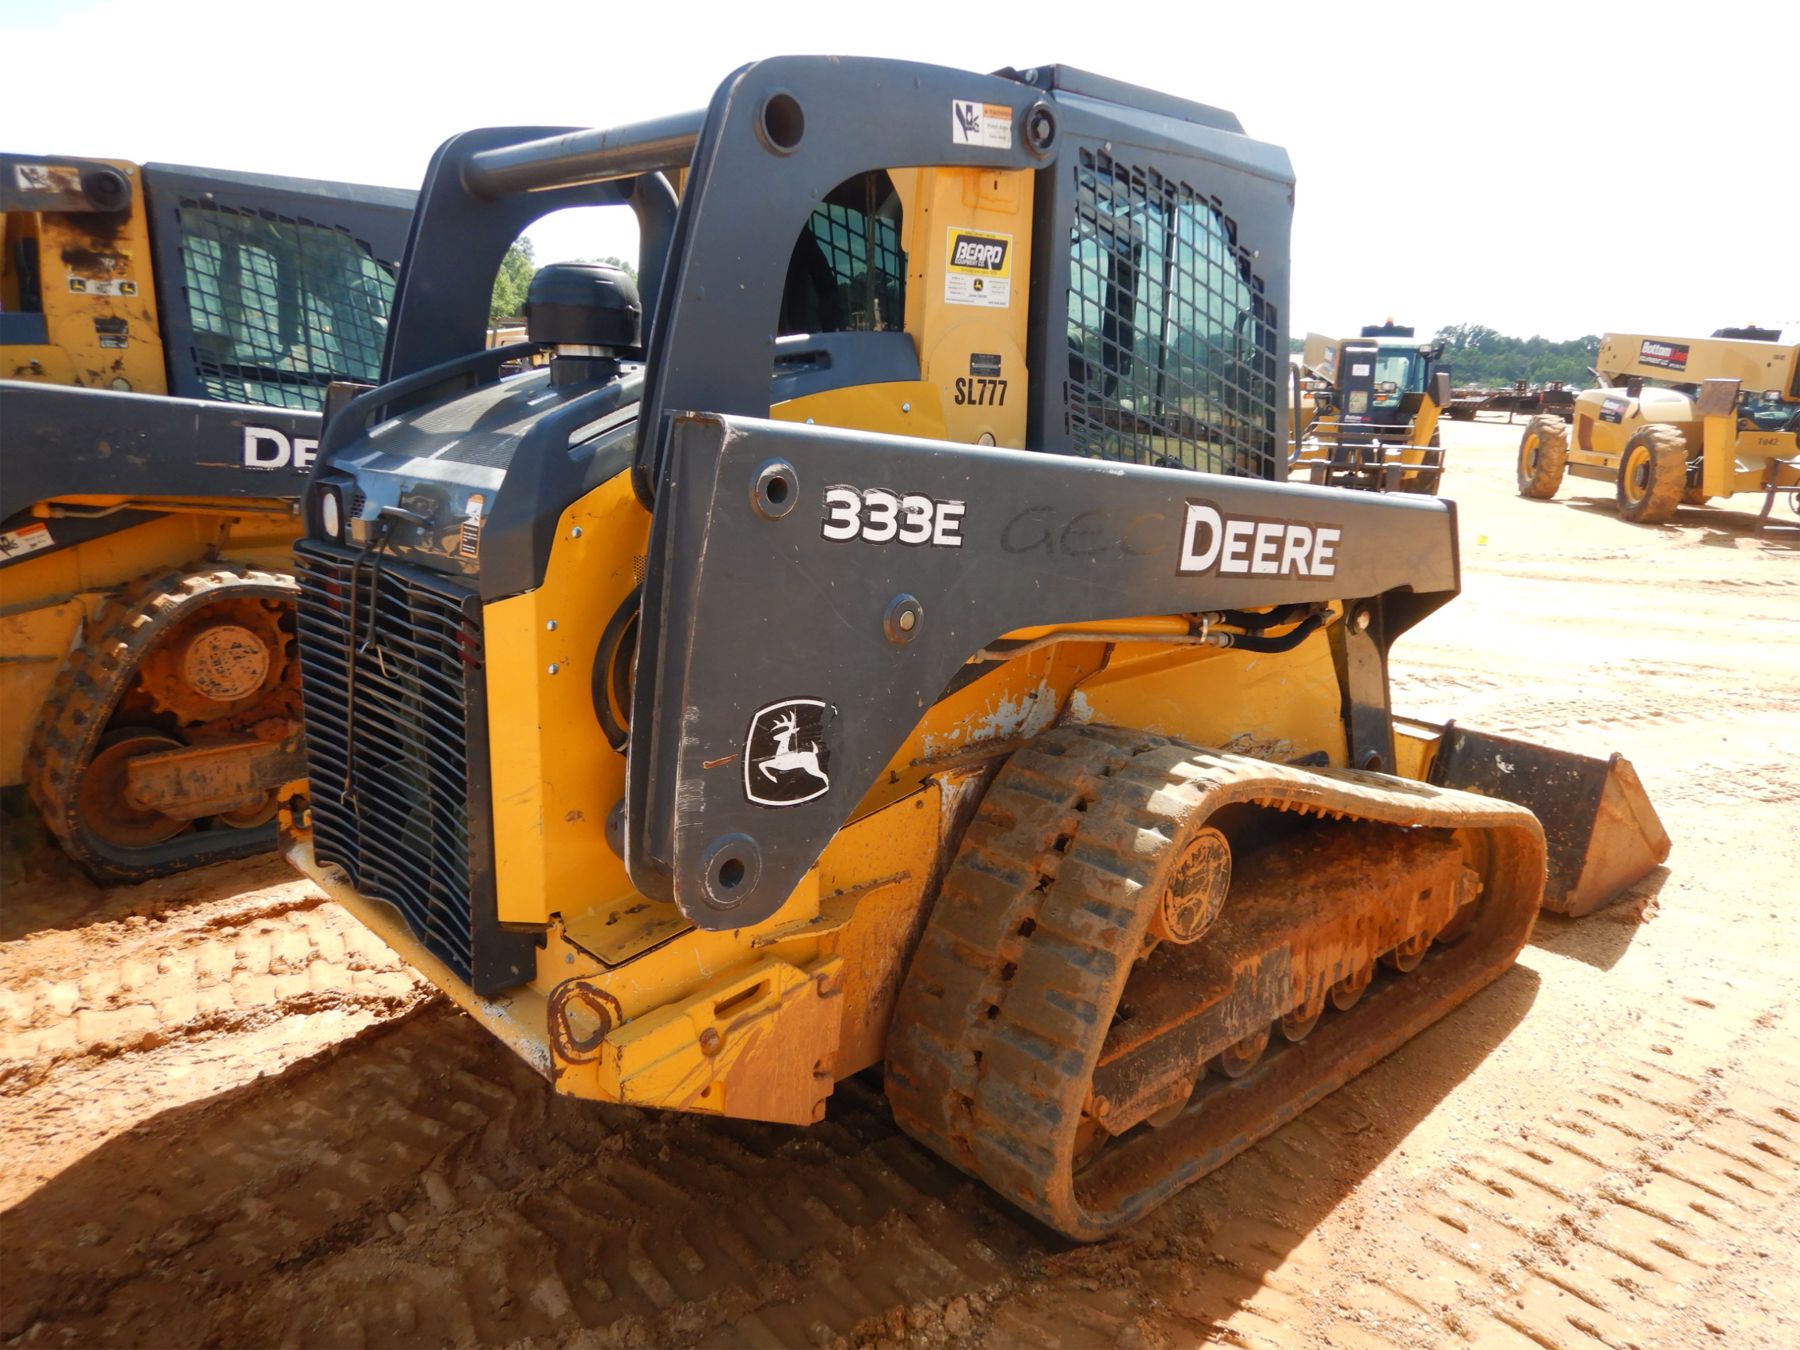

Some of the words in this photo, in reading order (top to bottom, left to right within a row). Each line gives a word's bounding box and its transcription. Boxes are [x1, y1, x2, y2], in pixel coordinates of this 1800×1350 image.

[955, 241, 1003, 270] BEARD
[954, 377, 1007, 406] SL777
[823, 489, 966, 546] 333E
[1180, 504, 1341, 577] DEERE
